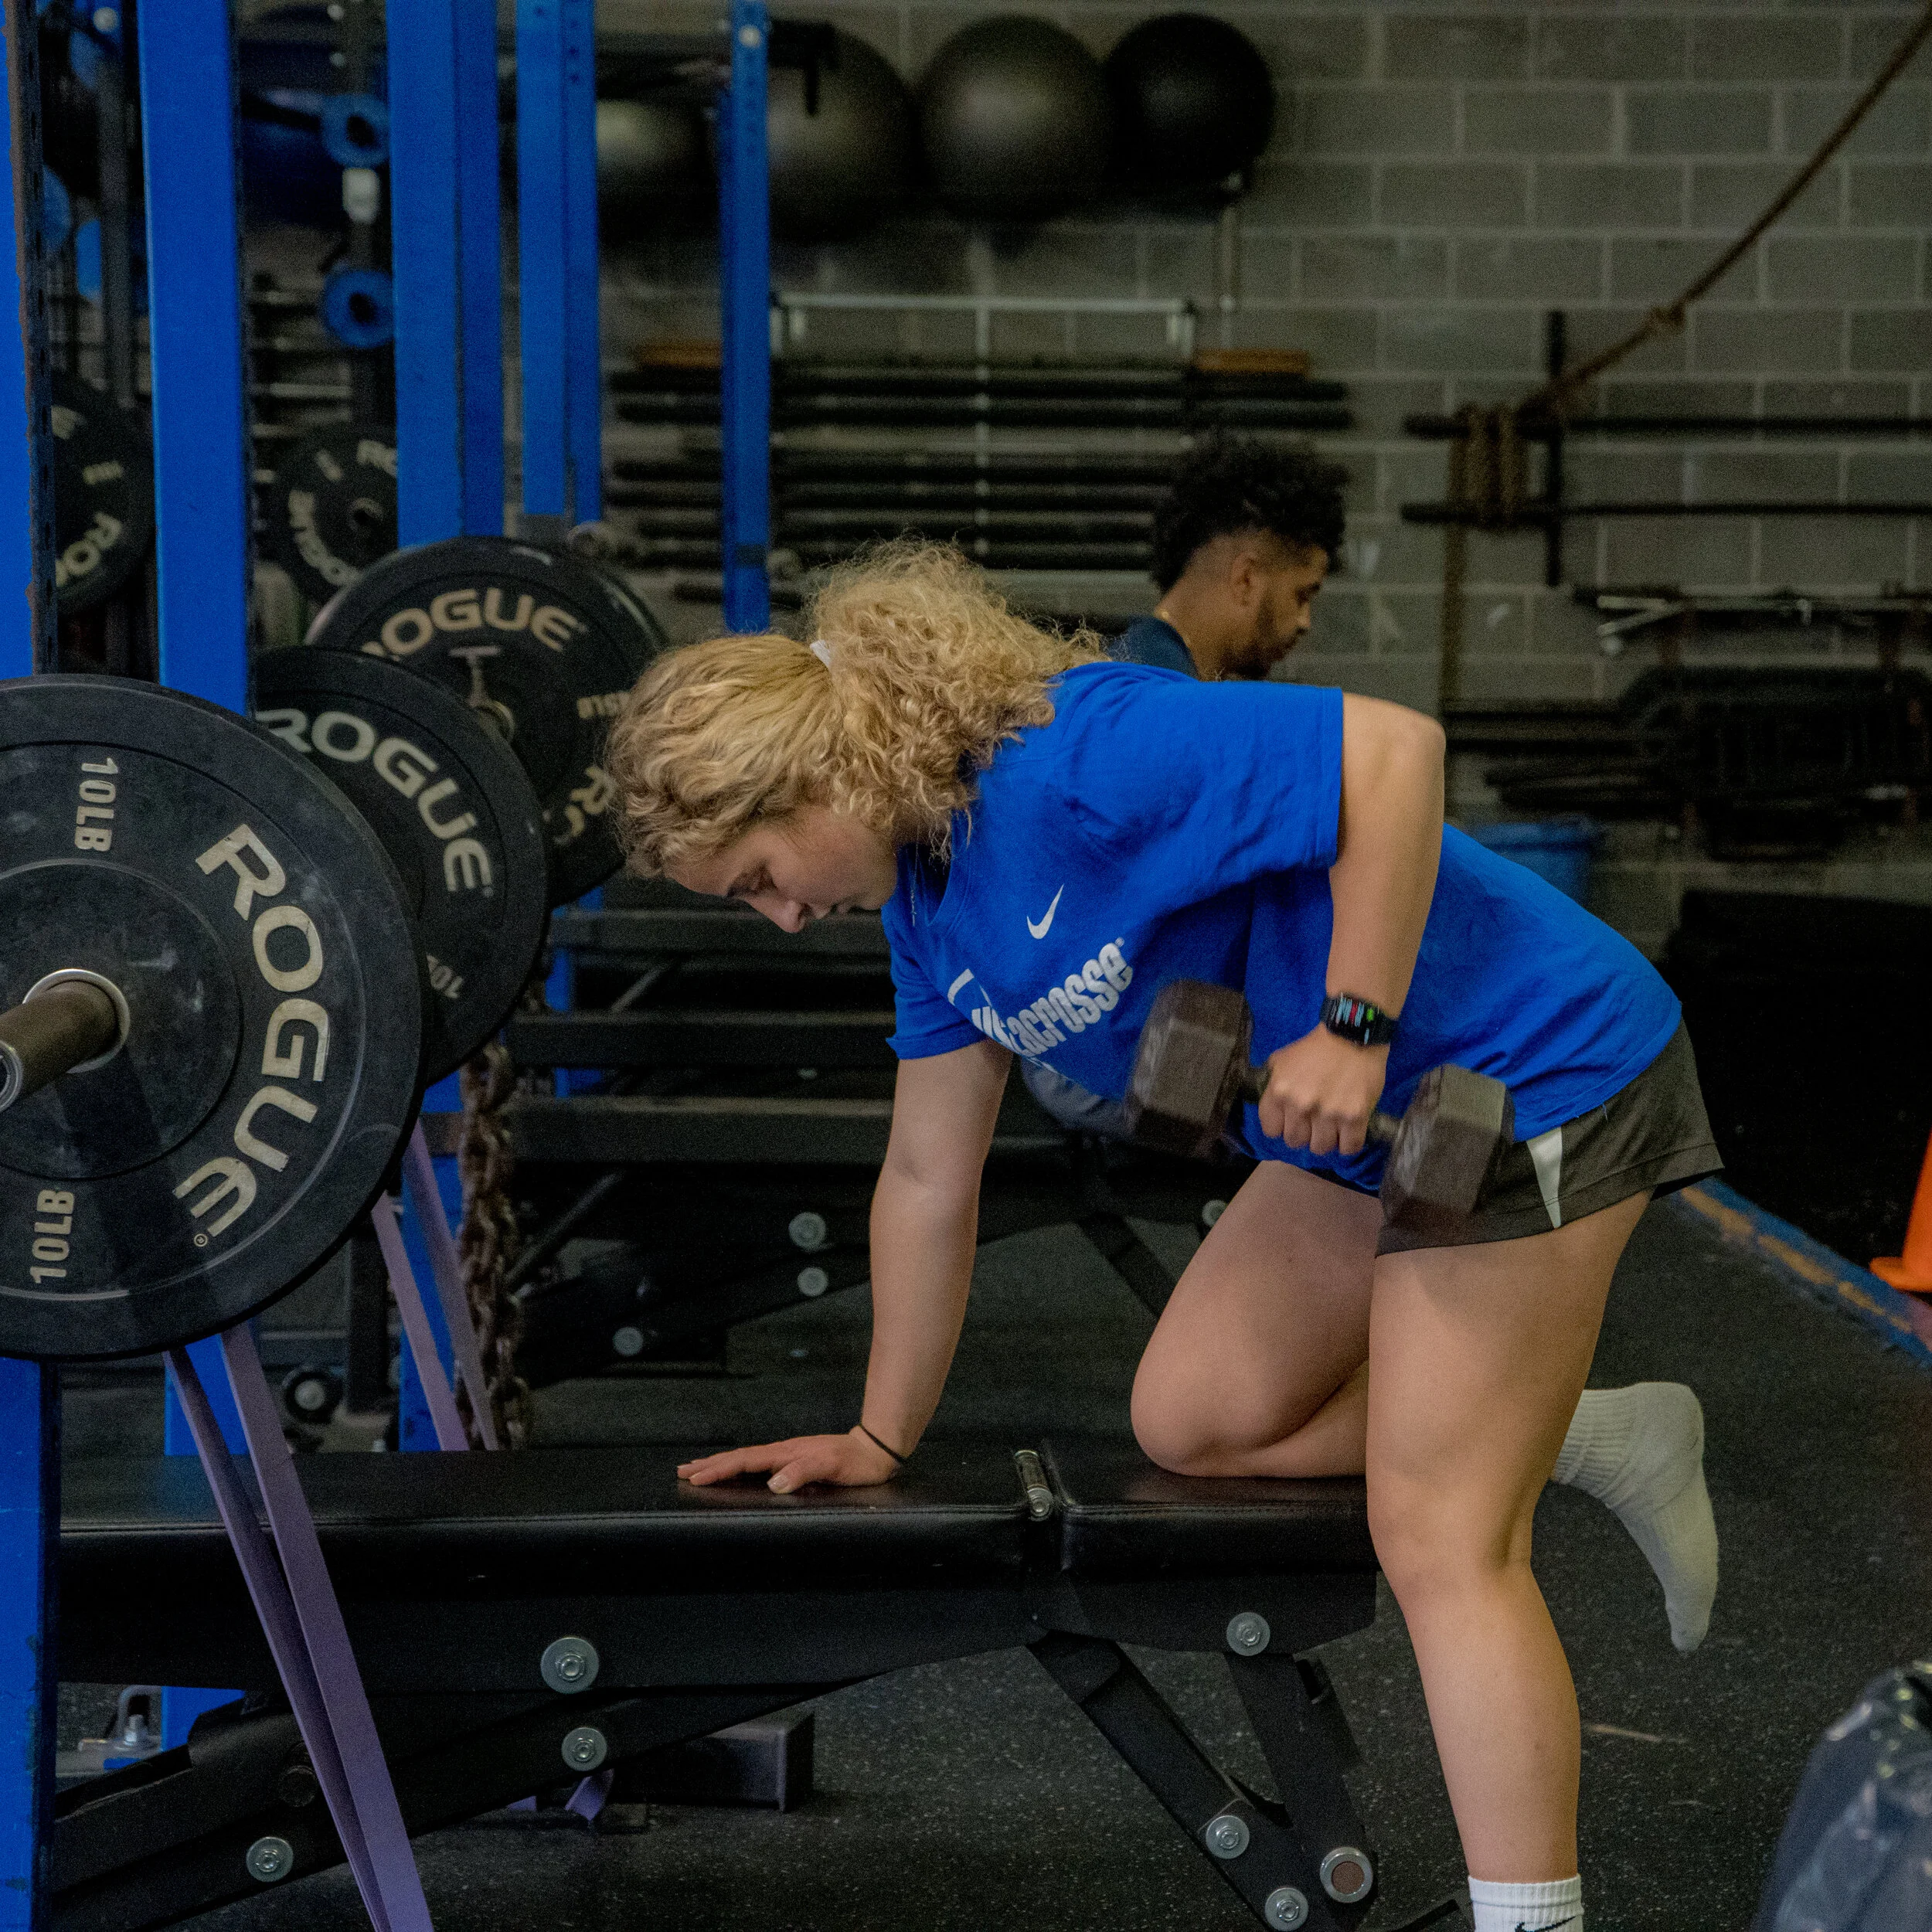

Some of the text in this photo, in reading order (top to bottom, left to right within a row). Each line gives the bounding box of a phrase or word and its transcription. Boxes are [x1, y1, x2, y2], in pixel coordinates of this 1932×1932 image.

[74, 757, 119, 852] 10LB
[255, 707, 492, 895] ROGUE
[172, 823, 331, 1238] ROGUE
[29, 1189, 75, 1284] 10LB
